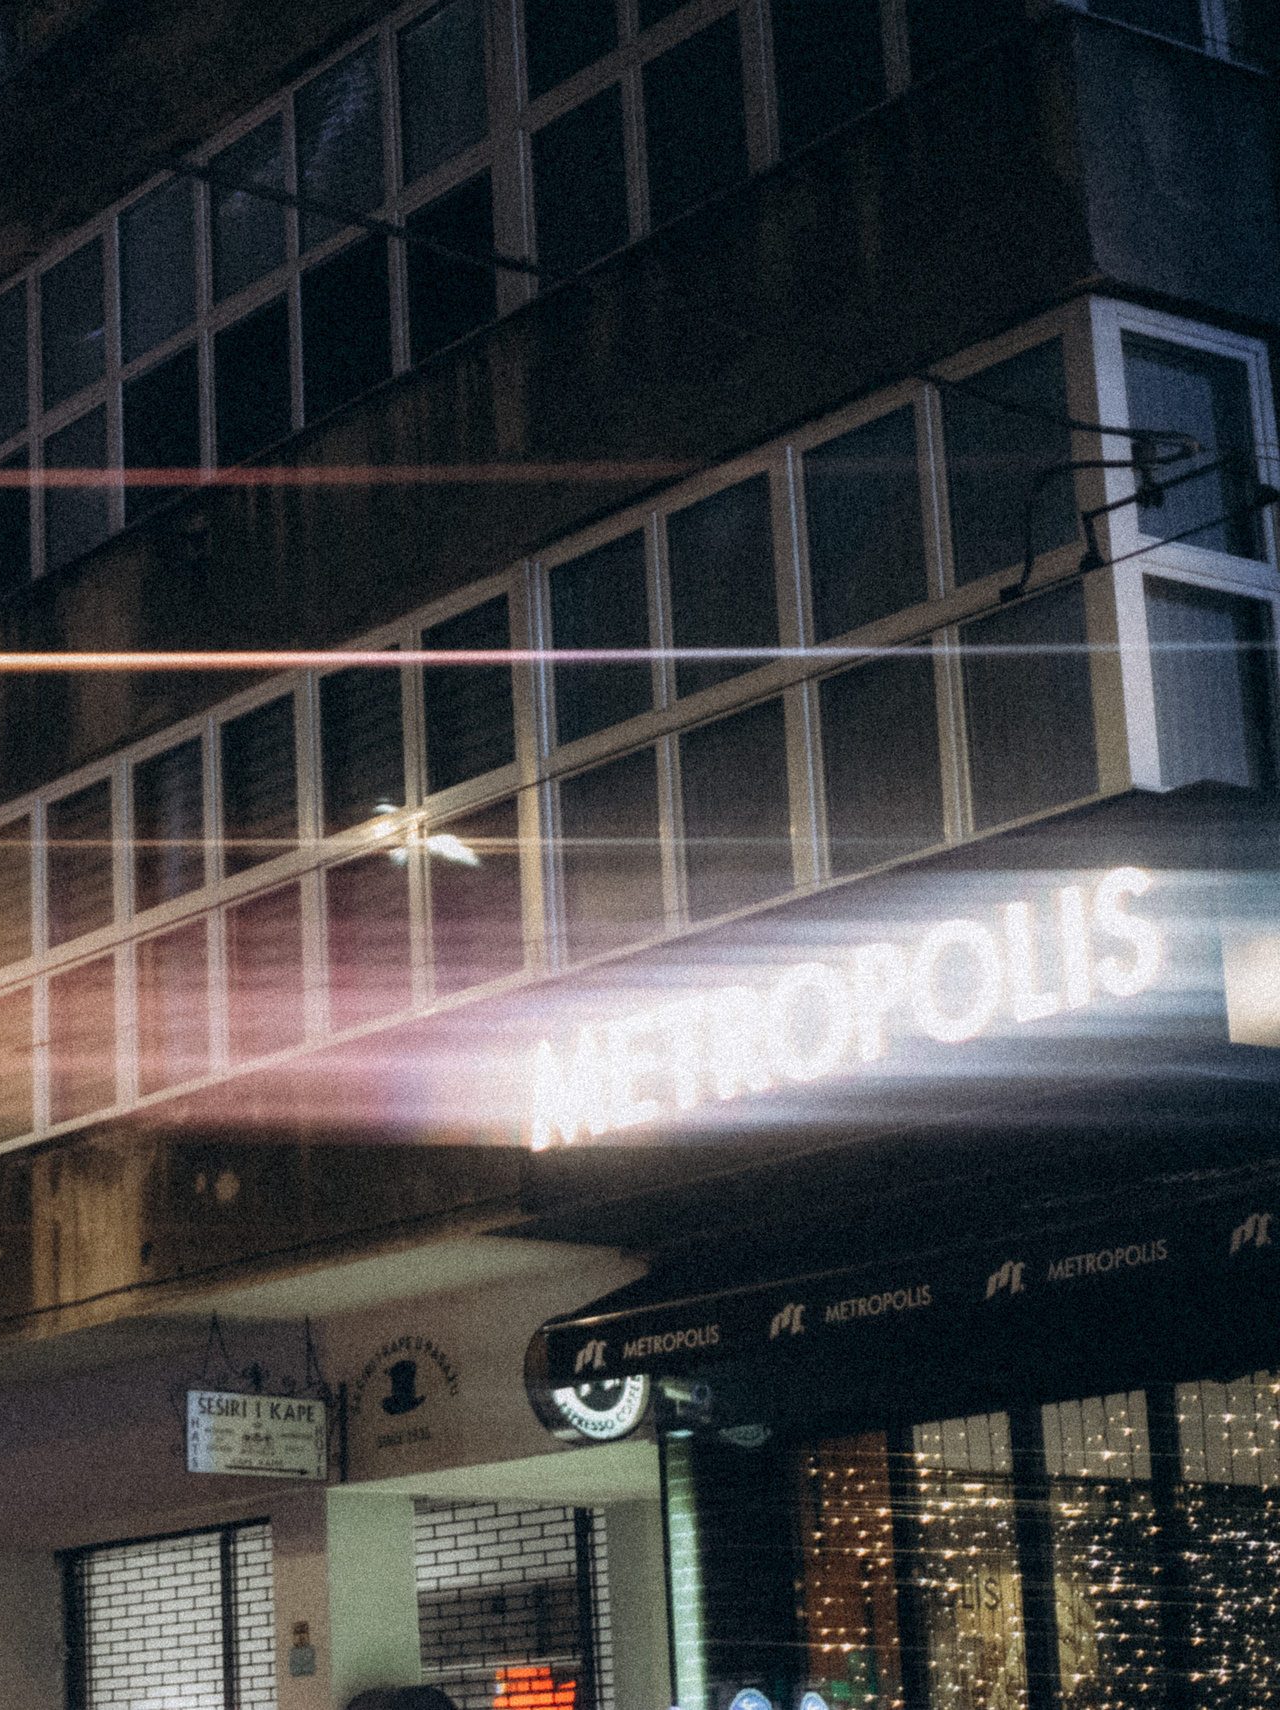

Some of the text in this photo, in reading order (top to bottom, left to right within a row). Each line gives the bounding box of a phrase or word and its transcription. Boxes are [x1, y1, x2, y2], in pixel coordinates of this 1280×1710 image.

[528, 866, 1166, 1154] METROPOLIS
[1047, 1239, 1169, 1283] METROPOLIS
[825, 1283, 932, 1325] METROPOLIS
[623, 1325, 721, 1361] METROPOLIS
[256, 1402, 261, 1418] I
[270, 1402, 316, 1423] KAPE
